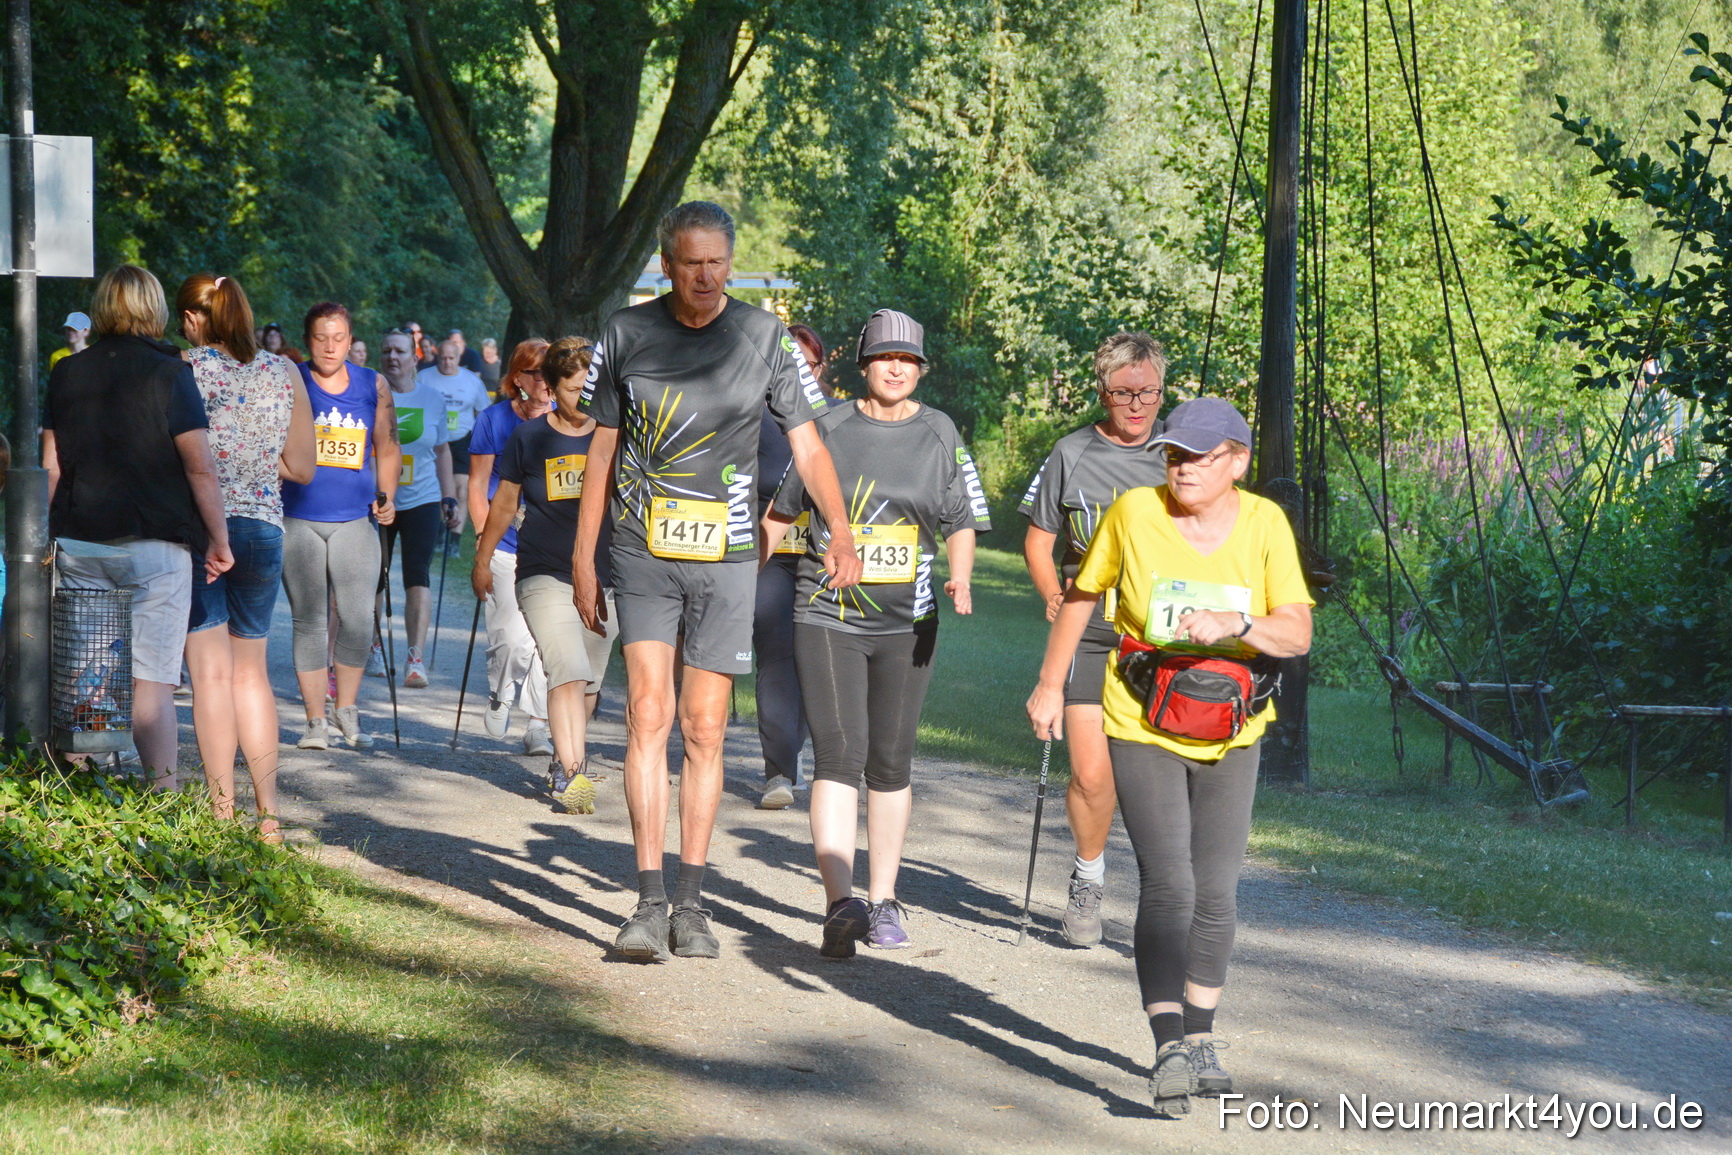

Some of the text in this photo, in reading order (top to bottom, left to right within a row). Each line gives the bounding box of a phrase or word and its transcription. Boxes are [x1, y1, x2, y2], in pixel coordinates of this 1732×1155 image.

[317, 439, 357, 457] 1353
[726, 473, 753, 545] now
[659, 518, 717, 543] 1417
[856, 545, 909, 566] 1433
